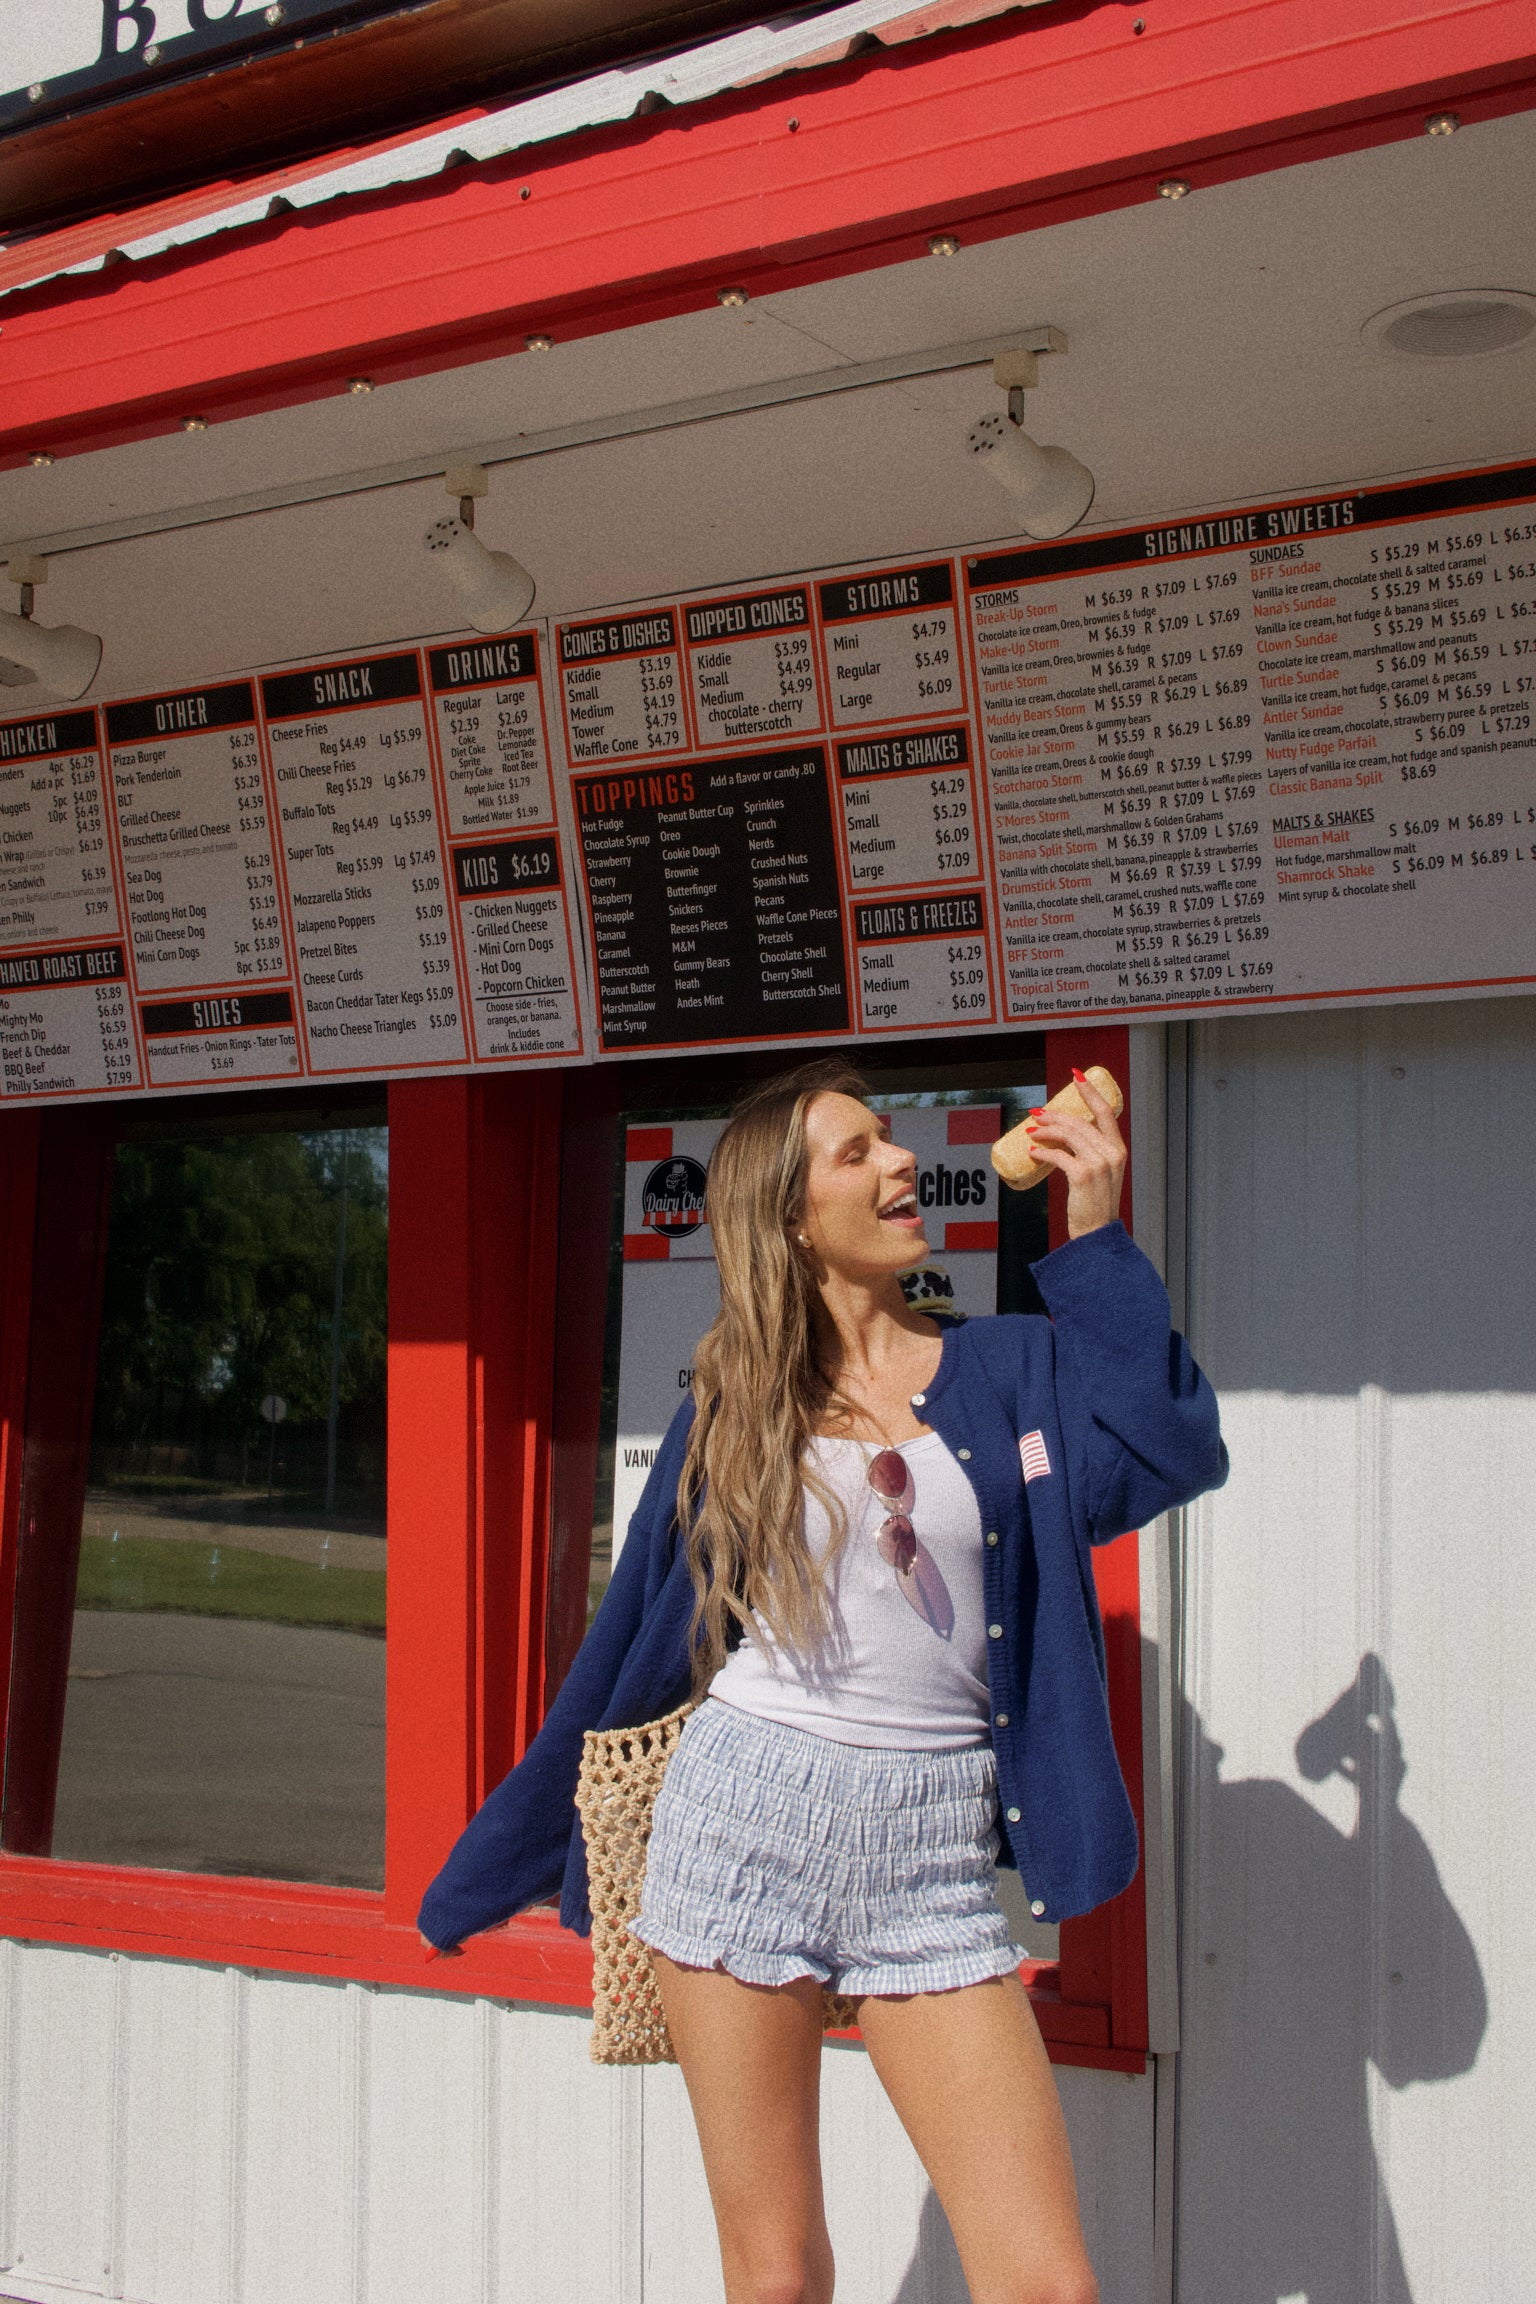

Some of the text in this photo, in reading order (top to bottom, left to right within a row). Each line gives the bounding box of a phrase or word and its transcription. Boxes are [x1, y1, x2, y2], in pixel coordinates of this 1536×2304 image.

[1145, 500, 1354, 557] SIGNATURE SWEETS
[1249, 543, 1304, 565] SUNDAES
[1250, 567, 1273, 582] BFF
[1279, 562, 1321, 577] Sundae
[1370, 549, 1379, 564] S
[1385, 543, 1420, 562] $5.29
[1427, 540, 1439, 555] M
[1446, 533, 1483, 553] $5.69
[1490, 531, 1499, 545] L
[847, 576, 920, 612] STORMS
[974, 589, 1019, 609] STORMS
[975, 571, 1237, 626] Break-Up Storm M $6.39 R $7.09 L $7.69
[689, 595, 805, 638] DIPPED CONES
[977, 607, 1157, 643] Chocolate ice cream, Oreo, brownies & fudge
[1254, 598, 1459, 635] Vanilla ice cream, hot fudge & banana slices
[563, 618, 671, 658] CONES & DISHES
[833, 620, 946, 652] Mini $4.79
[447, 643, 520, 683] DRINKS
[566, 655, 671, 685] Kiddie $3.19
[313, 667, 373, 704] SNACK
[700, 677, 813, 707] Medium $4.99
[155, 697, 208, 731] OTHER
[443, 691, 525, 715] Regular Large
[0, 722, 57, 757] HICKEN
[271, 722, 328, 742] Cheese Fries
[319, 727, 422, 757] Reg $4.49 Lg $5.99
[573, 730, 680, 757] Waffle Cone $4.79
[113, 732, 255, 767] Pizza Burger $6.29
[845, 734, 959, 773] MALTS & SHAKES
[49, 755, 94, 776] 4pc $6.29
[115, 753, 258, 787] Pork Tenderloin $6.39
[1268, 763, 1437, 796] Classic Banana Split $8.69
[117, 774, 260, 808] BLT $5.29
[577, 772, 695, 814] TOPPINGS
[845, 777, 965, 807] Mini $4.29
[657, 804, 735, 824] Peanut Butter Cup
[743, 798, 785, 815] Sprinkles
[1272, 807, 1375, 831] MALTS & SHAKES
[581, 818, 624, 833] Hot Fudge
[462, 852, 550, 888] KIDS $6.19
[750, 853, 809, 870] Crushed Nuts
[852, 851, 970, 881] Large $7.09
[293, 877, 440, 906] Mozzarella Sticks $5.09
[591, 892, 633, 907] Raspberry
[666, 883, 718, 898] Butterfinger
[1278, 879, 1417, 903] Mint syrup & chocolate shell
[860, 900, 977, 935] FLOATS & FREEZES
[672, 940, 696, 953] M&M
[0, 951, 117, 984] HAVED ROAST BEEF
[762, 983, 842, 1002] Butterscotch Shell
[1012, 983, 1274, 1014] Dairy free flavor of the day, banana, pineapple & strawberry
[192, 998, 242, 1028] SIDES
[309, 1013, 457, 1038] Nacho Cheese Triangles $5.09
[487, 1011, 560, 1027] oranges, or banana.
[603, 1019, 648, 1033] Mint Syrup
[490, 1040, 565, 1054] drink & kiddie cone
[211, 1056, 234, 1071] $3.69
[646, 1192, 681, 1216] Dairy
